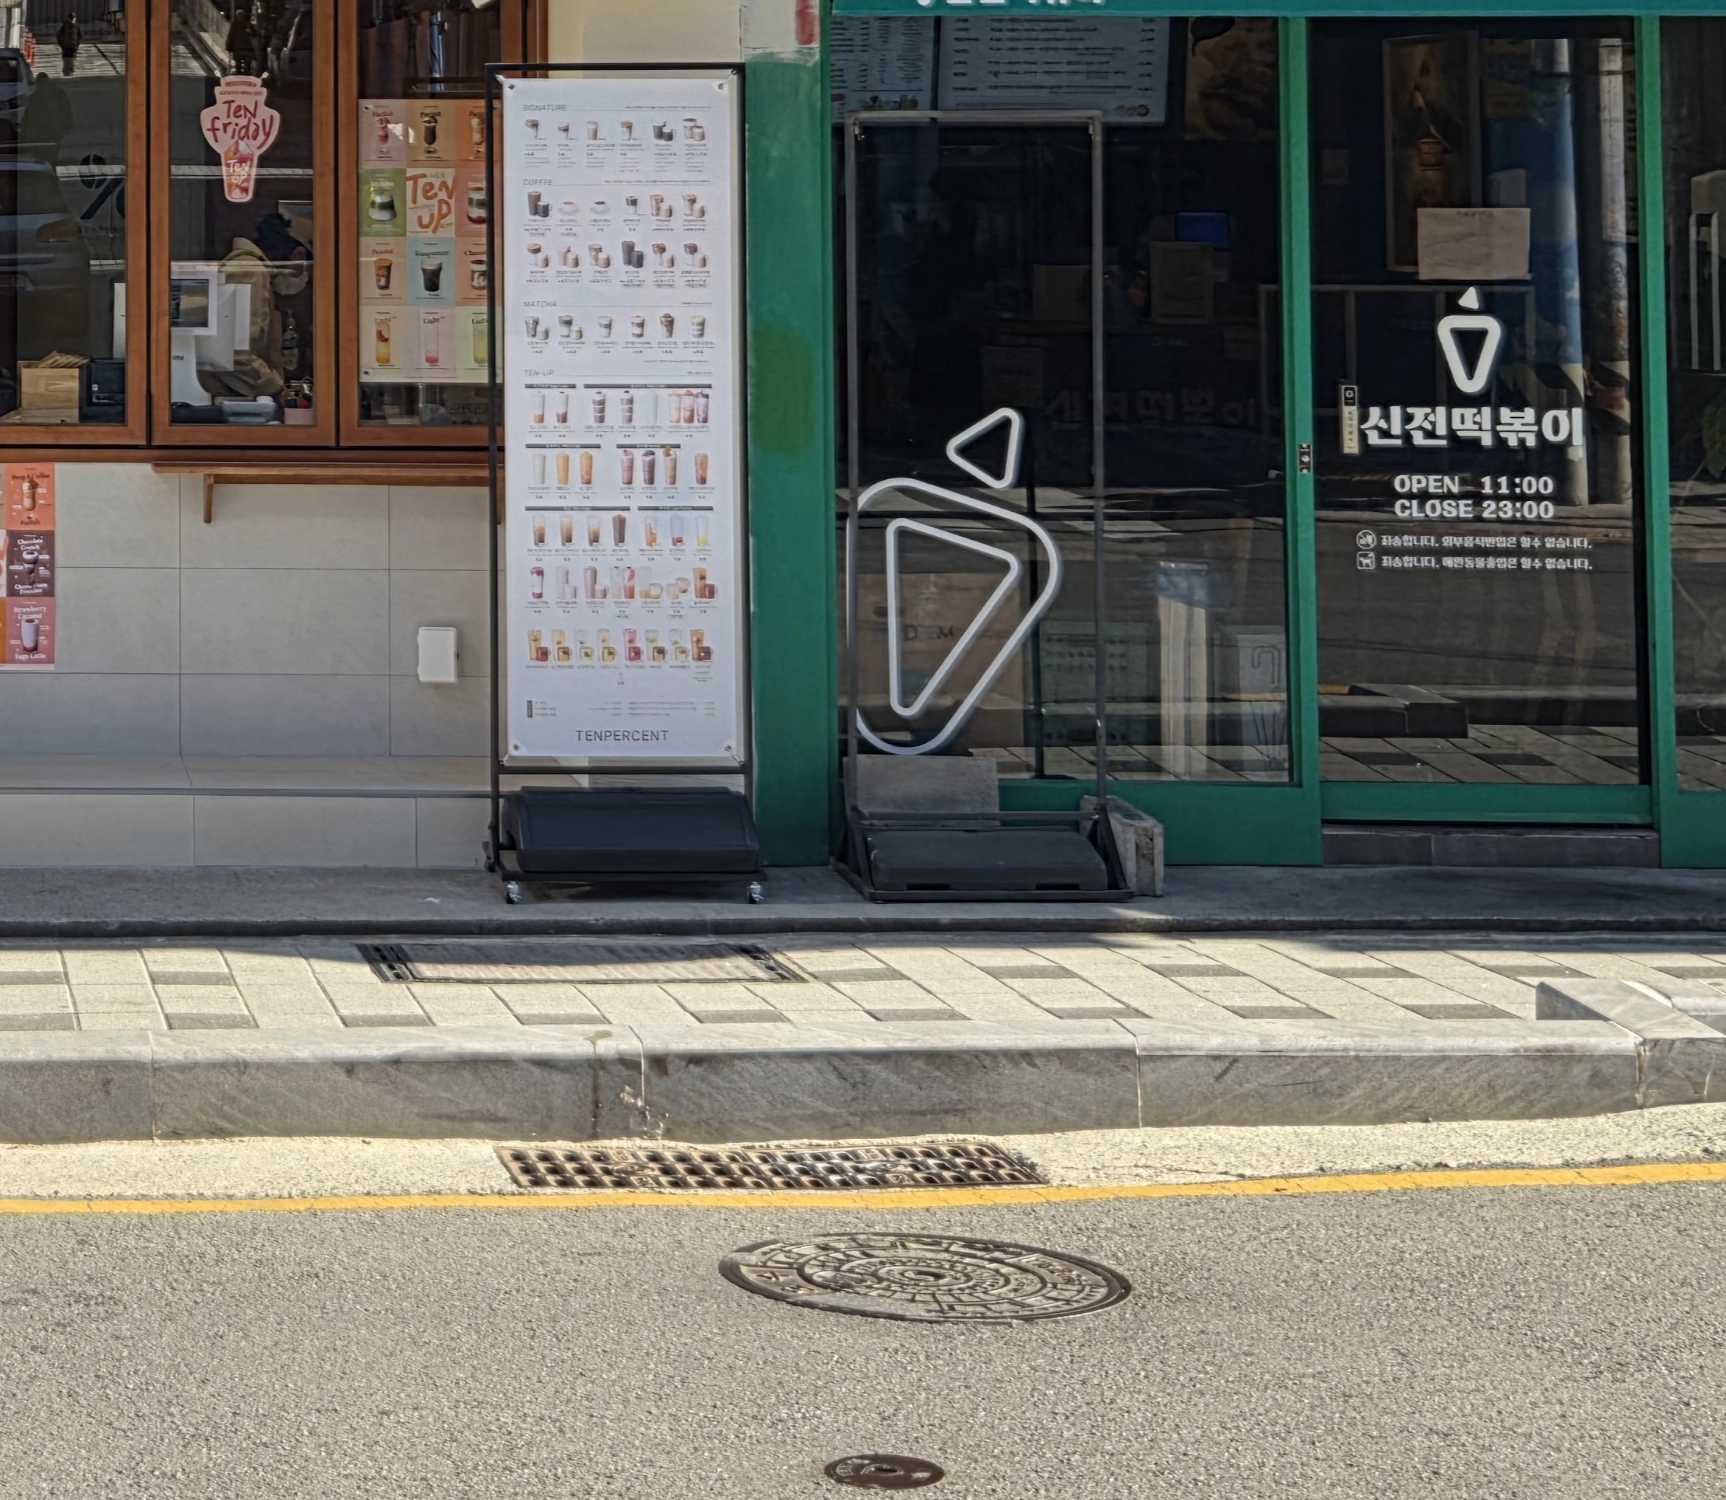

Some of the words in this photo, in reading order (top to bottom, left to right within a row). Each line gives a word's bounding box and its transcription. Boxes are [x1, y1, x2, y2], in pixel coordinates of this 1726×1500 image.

[522, 104, 567, 112] SIGNATURE
[523, 179, 553, 187] COFFEE
[523, 300, 558, 308] MATCHA
[523, 369, 555, 378] TEN-UP
[1360, 405, 1584, 449] 신전떡볶이
[1393, 474, 1460, 495] OPEN
[1480, 475, 1554, 495] 11:00
[1393, 498, 1475, 519] CLOSE
[1481, 499, 1554, 519] 23:00
[1380, 534, 1440, 548] 죄송합니다.
[1519, 535, 1542, 548] 할수
[1544, 535, 1593, 549] 없습니다.
[1380, 555, 1440, 569] 죄송합니다.
[1520, 556, 1543, 569] 할수
[1544, 556, 1594, 570] 없습니다.
[575, 729, 670, 743] TENPERCENT
